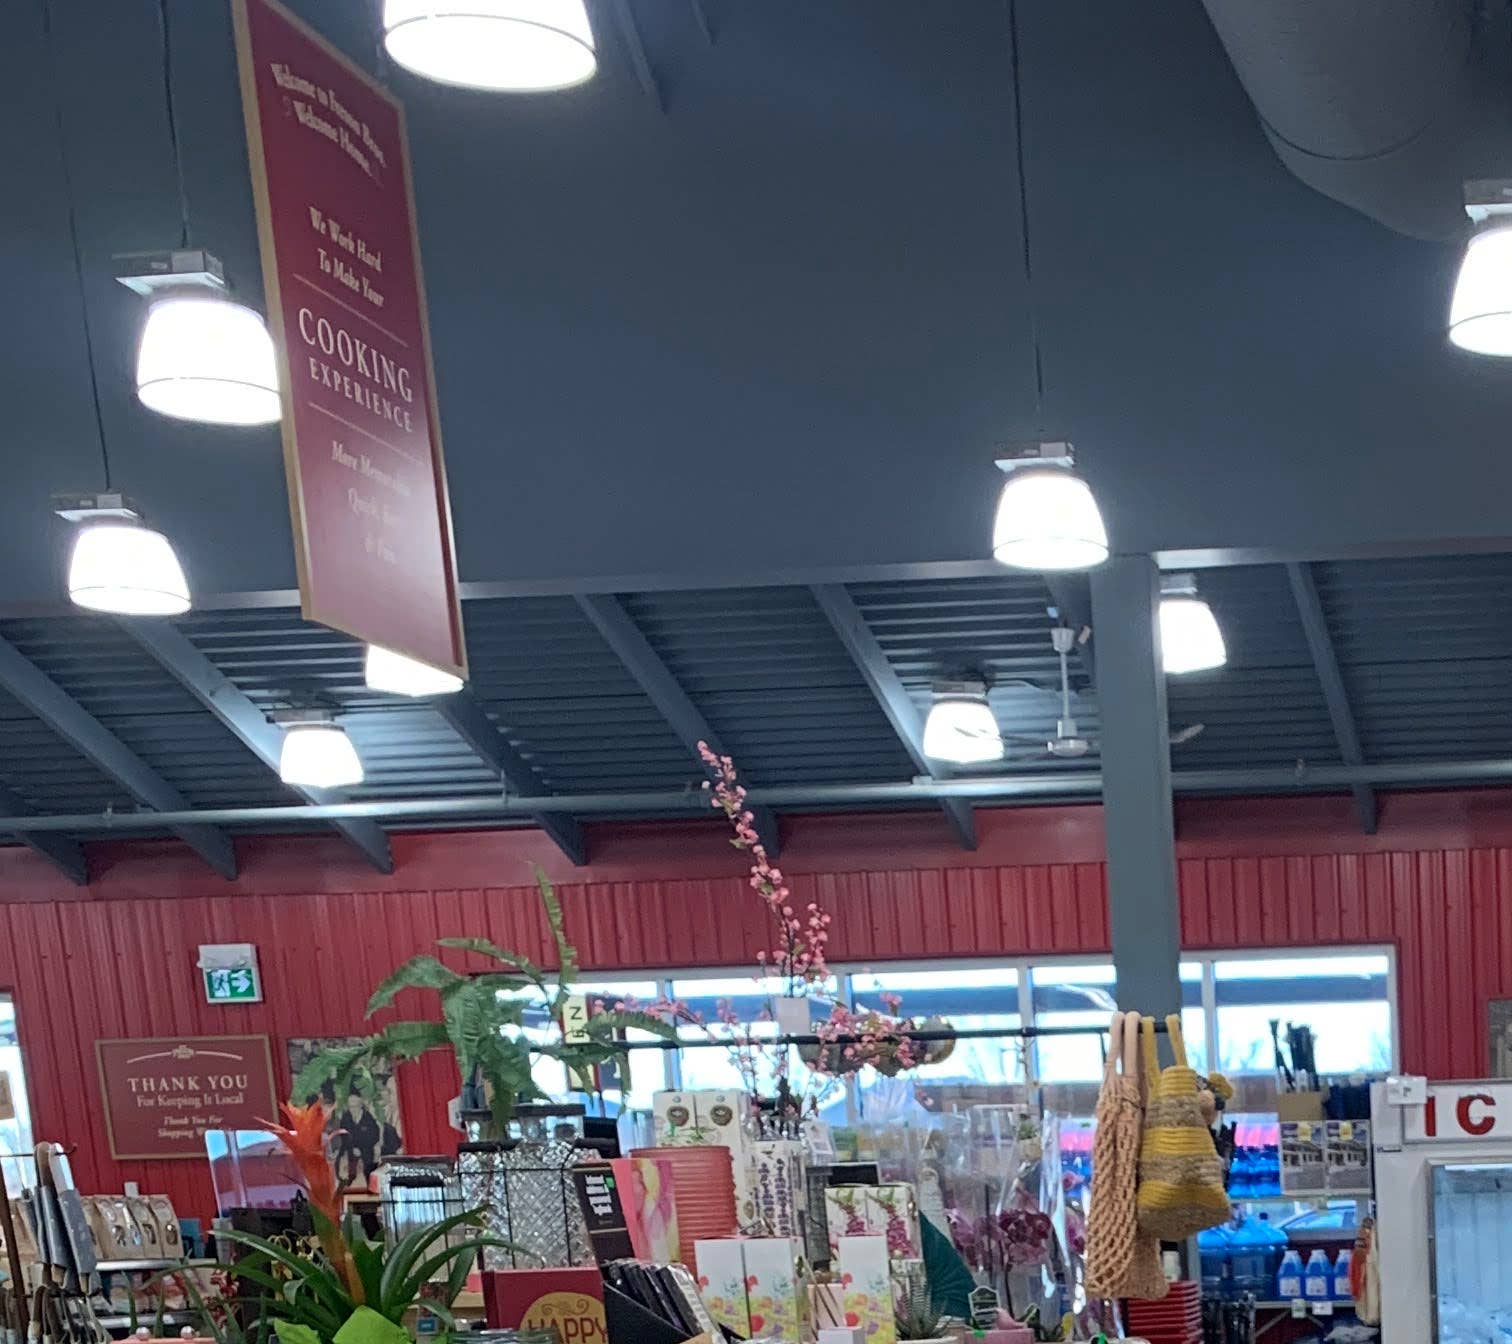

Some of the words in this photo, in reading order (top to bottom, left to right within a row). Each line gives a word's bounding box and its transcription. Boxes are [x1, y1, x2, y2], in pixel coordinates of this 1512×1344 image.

[309, 206, 326, 235] We
[328, 219, 355, 254] Work
[357, 239, 382, 272] Hard
[318, 248, 331, 273] To
[333, 257, 359, 292] Make
[299, 308, 412, 404] COOKING
[308, 357, 413, 433] EXPERIENCE
[127, 1076, 200, 1093] THANK
[208, 1074, 249, 1090] YOU
[158, 1094, 202, 1109] Keeping
[214, 1092, 244, 1105] Local
